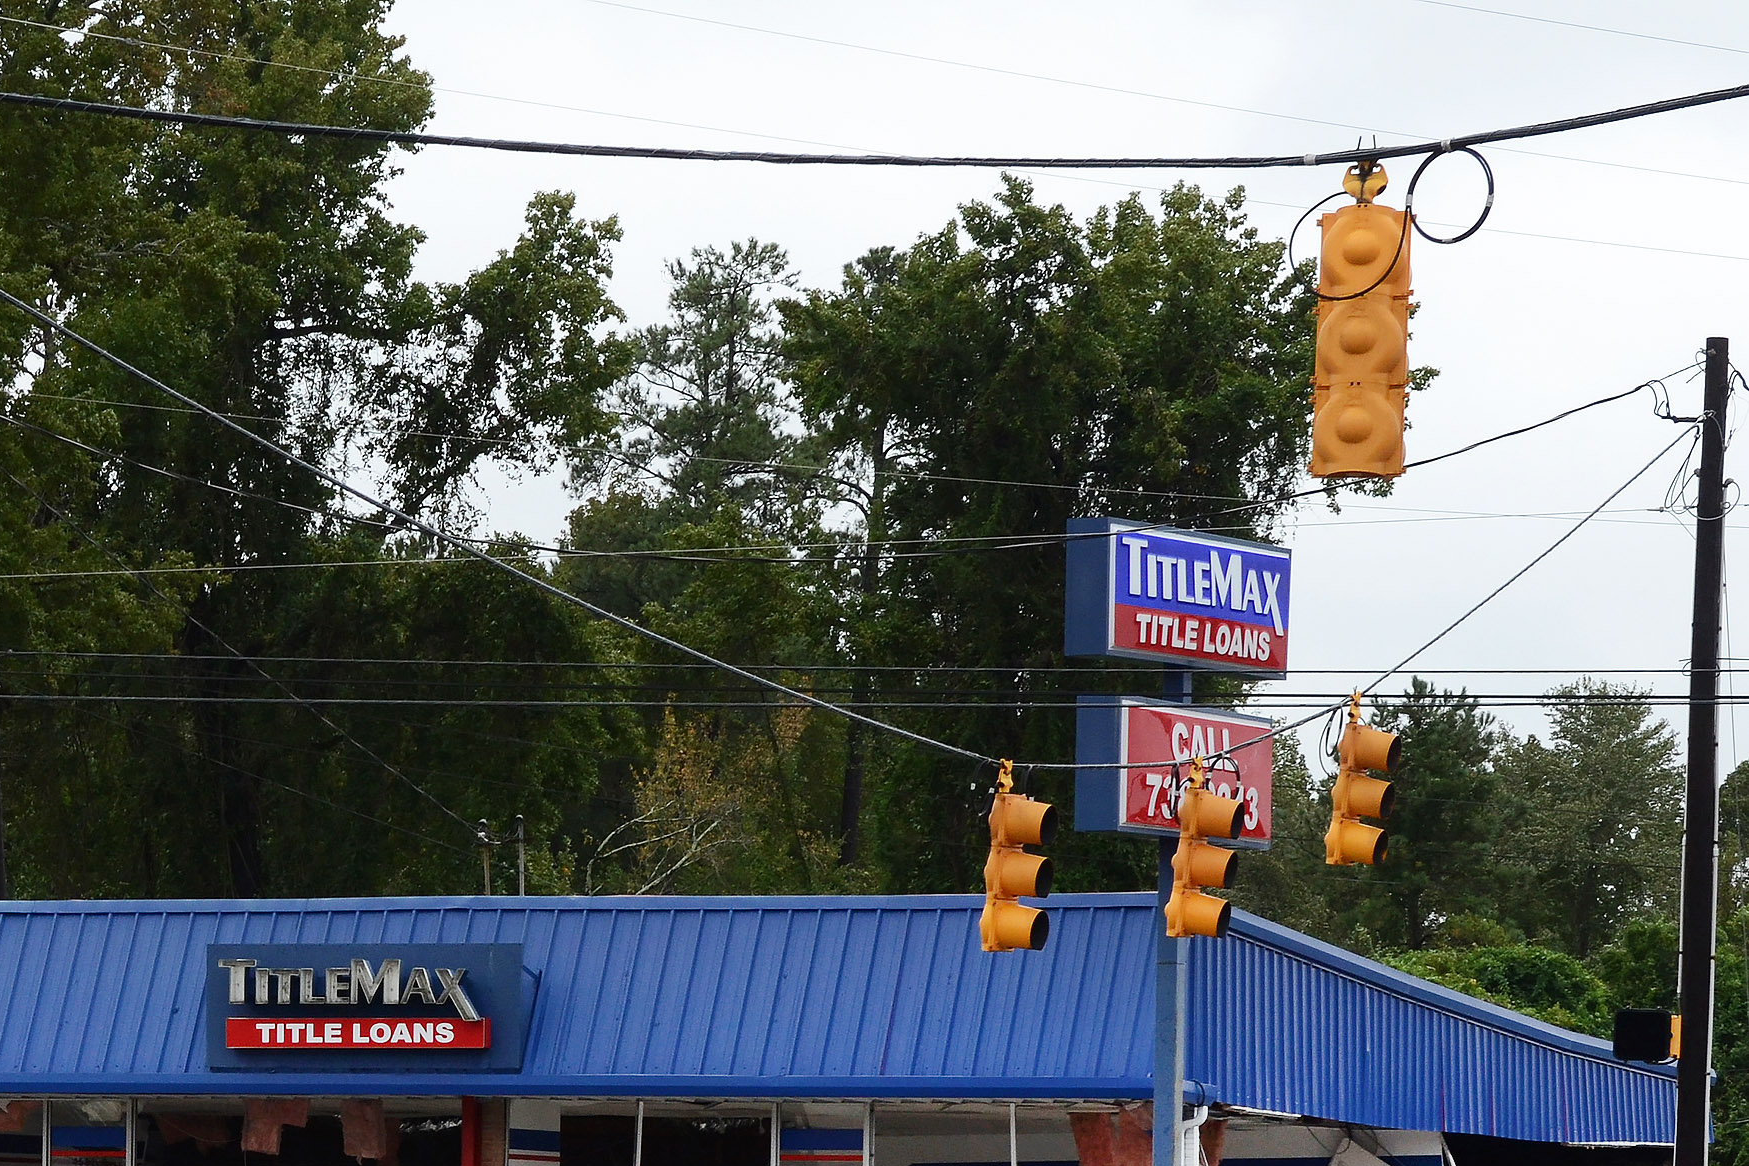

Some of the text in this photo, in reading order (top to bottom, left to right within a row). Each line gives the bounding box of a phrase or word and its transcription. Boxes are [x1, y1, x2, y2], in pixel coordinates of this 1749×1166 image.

[1122, 536, 1285, 636] TITLEMAX
[1136, 613, 1271, 661] TITLE LOANS
[1172, 722, 1237, 772] CALL
[217, 957, 481, 1021] TITLEMAX
[255, 1022, 455, 1044] TITLE LOANS
